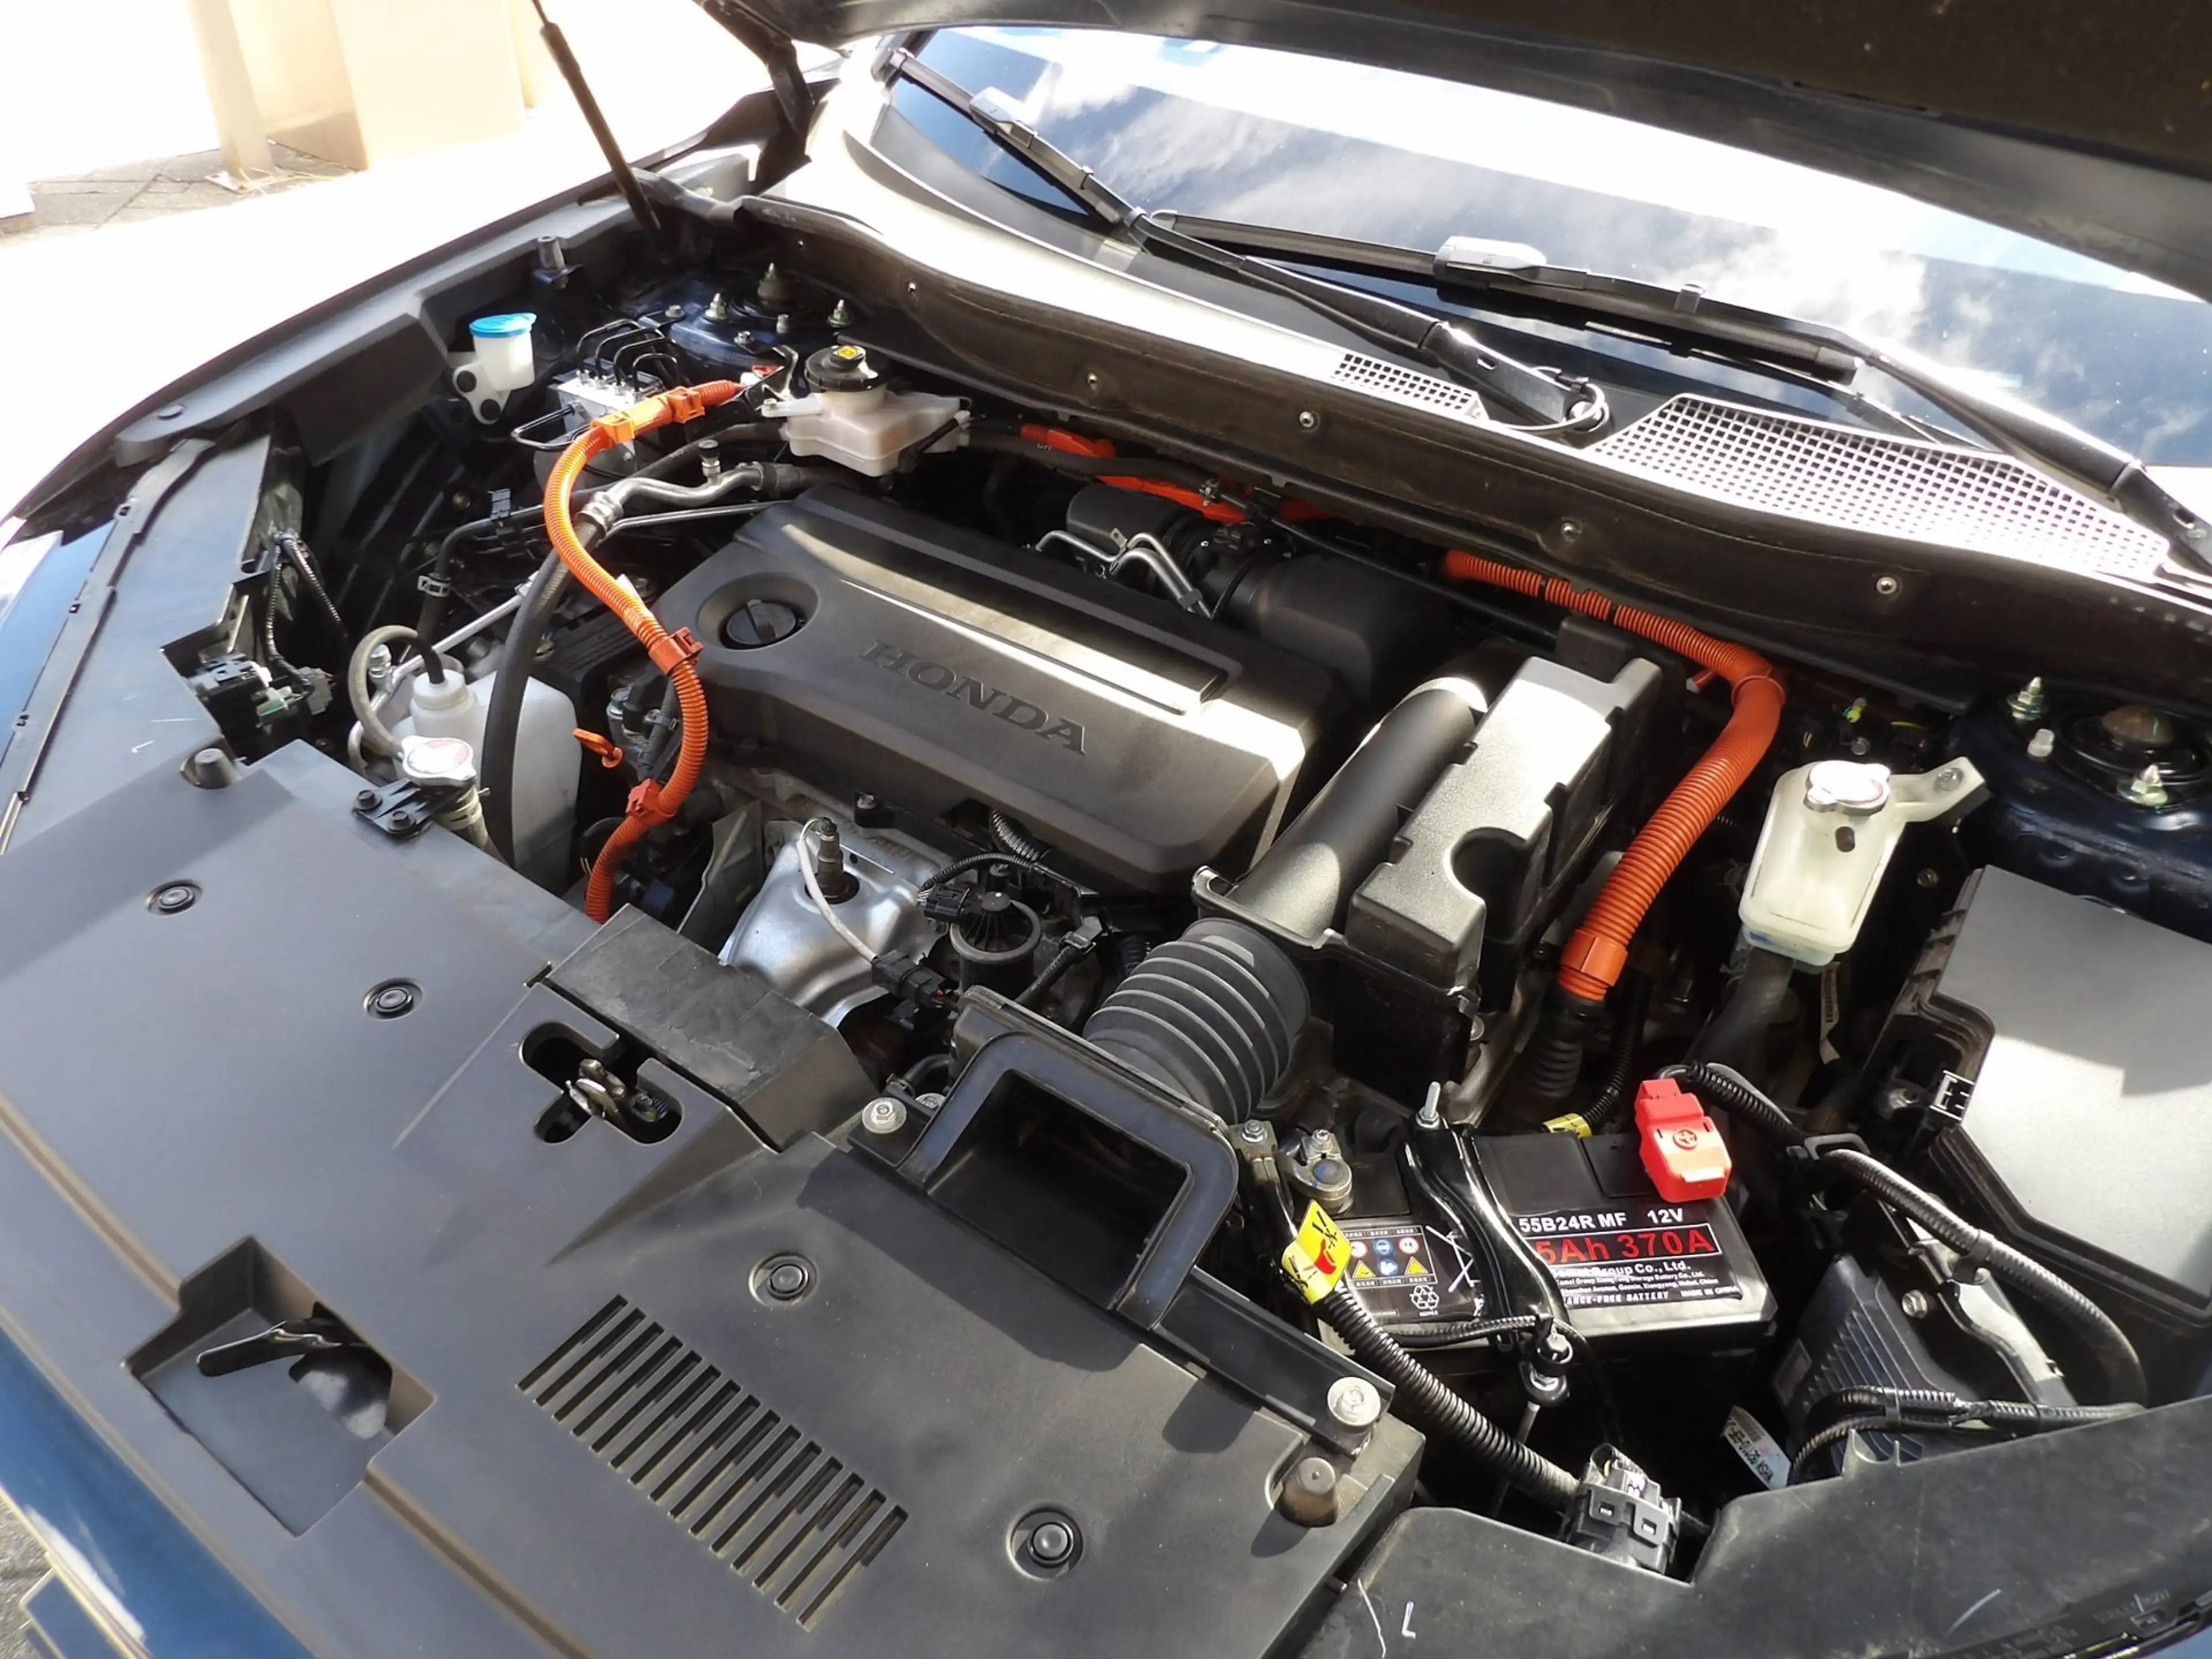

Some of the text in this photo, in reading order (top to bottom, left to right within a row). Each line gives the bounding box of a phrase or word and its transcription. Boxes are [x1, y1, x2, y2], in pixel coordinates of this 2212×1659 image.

[859, 639, 1088, 756] HONDA
[1518, 1208, 1684, 1233] 55B24R MF 12V
[1616, 1228, 1715, 1258] 370A
[1634, 1263, 1663, 1274] Co.,
[1662, 1260, 1691, 1271] Ltd.
[1563, 1290, 1669, 1306] ANCE-FREE BATTERY
